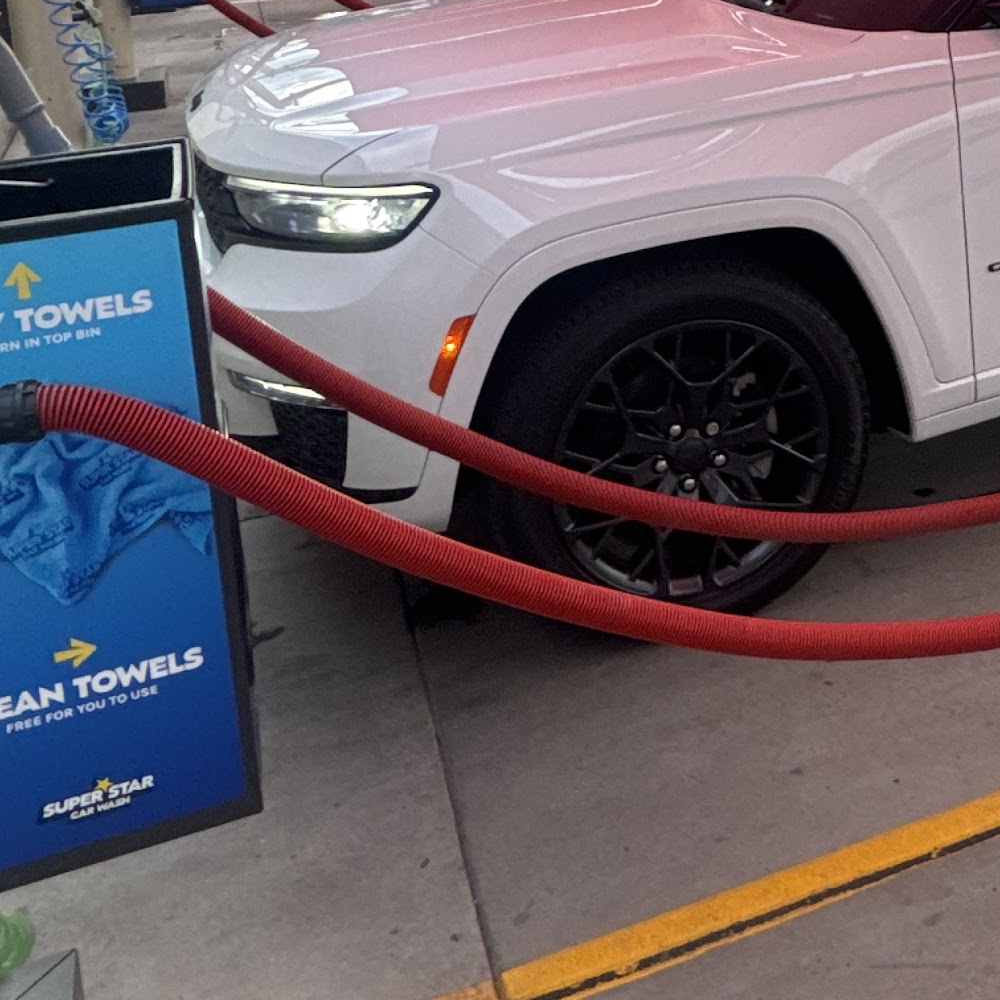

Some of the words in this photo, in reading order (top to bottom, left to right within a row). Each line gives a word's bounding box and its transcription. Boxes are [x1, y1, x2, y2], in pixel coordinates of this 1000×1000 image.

[14, 289, 153, 332] TOWELS
[24, 337, 41, 349] IN
[43, 331, 73, 345] TOP
[75, 326, 101, 340] BIN
[72, 646, 204, 699] TOWELS
[6, 715, 42, 734] FREE
[45, 707, 74, 724] FOR
[76, 699, 106, 714] YOU
[108, 694, 128, 706] TO
[130, 684, 158, 700] USE
[42, 789, 103, 819] SUPER
[108, 775, 155, 799] STAR
[69, 806, 95, 820] CAR
[96, 795, 132, 812] WASH
